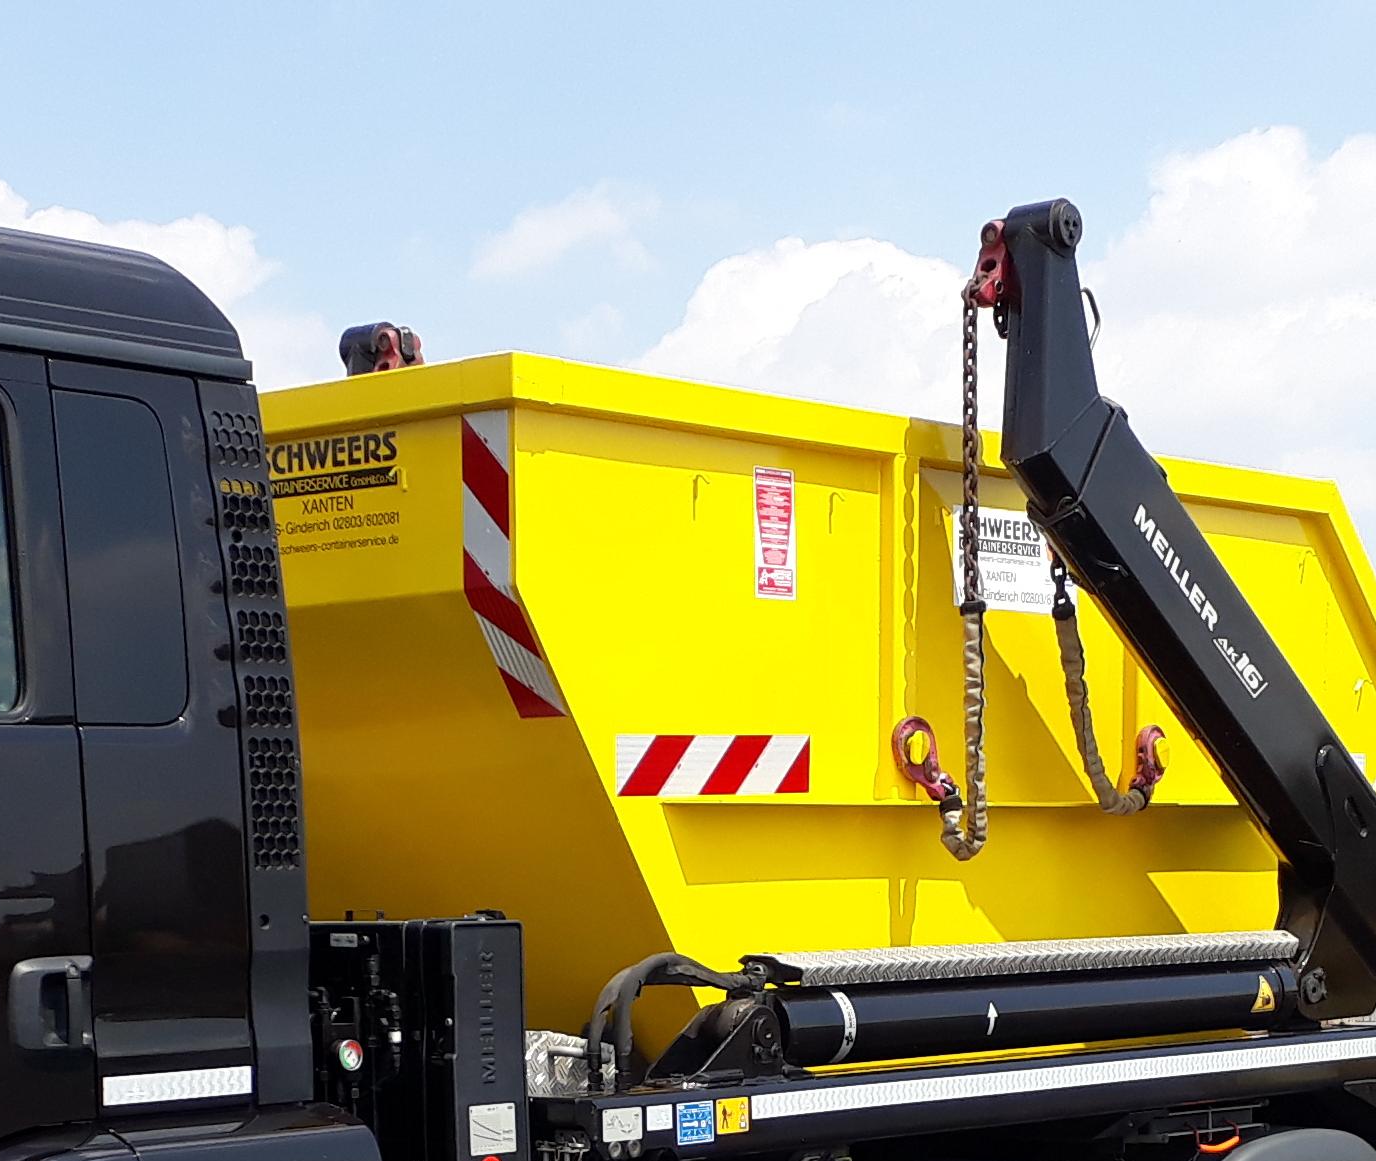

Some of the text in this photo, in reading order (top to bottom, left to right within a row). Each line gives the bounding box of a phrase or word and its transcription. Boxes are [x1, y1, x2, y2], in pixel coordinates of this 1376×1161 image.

[302, 495, 354, 515] XANTEN
[275, 511, 400, 536] S-Ginderich 02803/802081
[986, 569, 1017, 583] XANTEN
[1133, 503, 1219, 632] MEILLER
